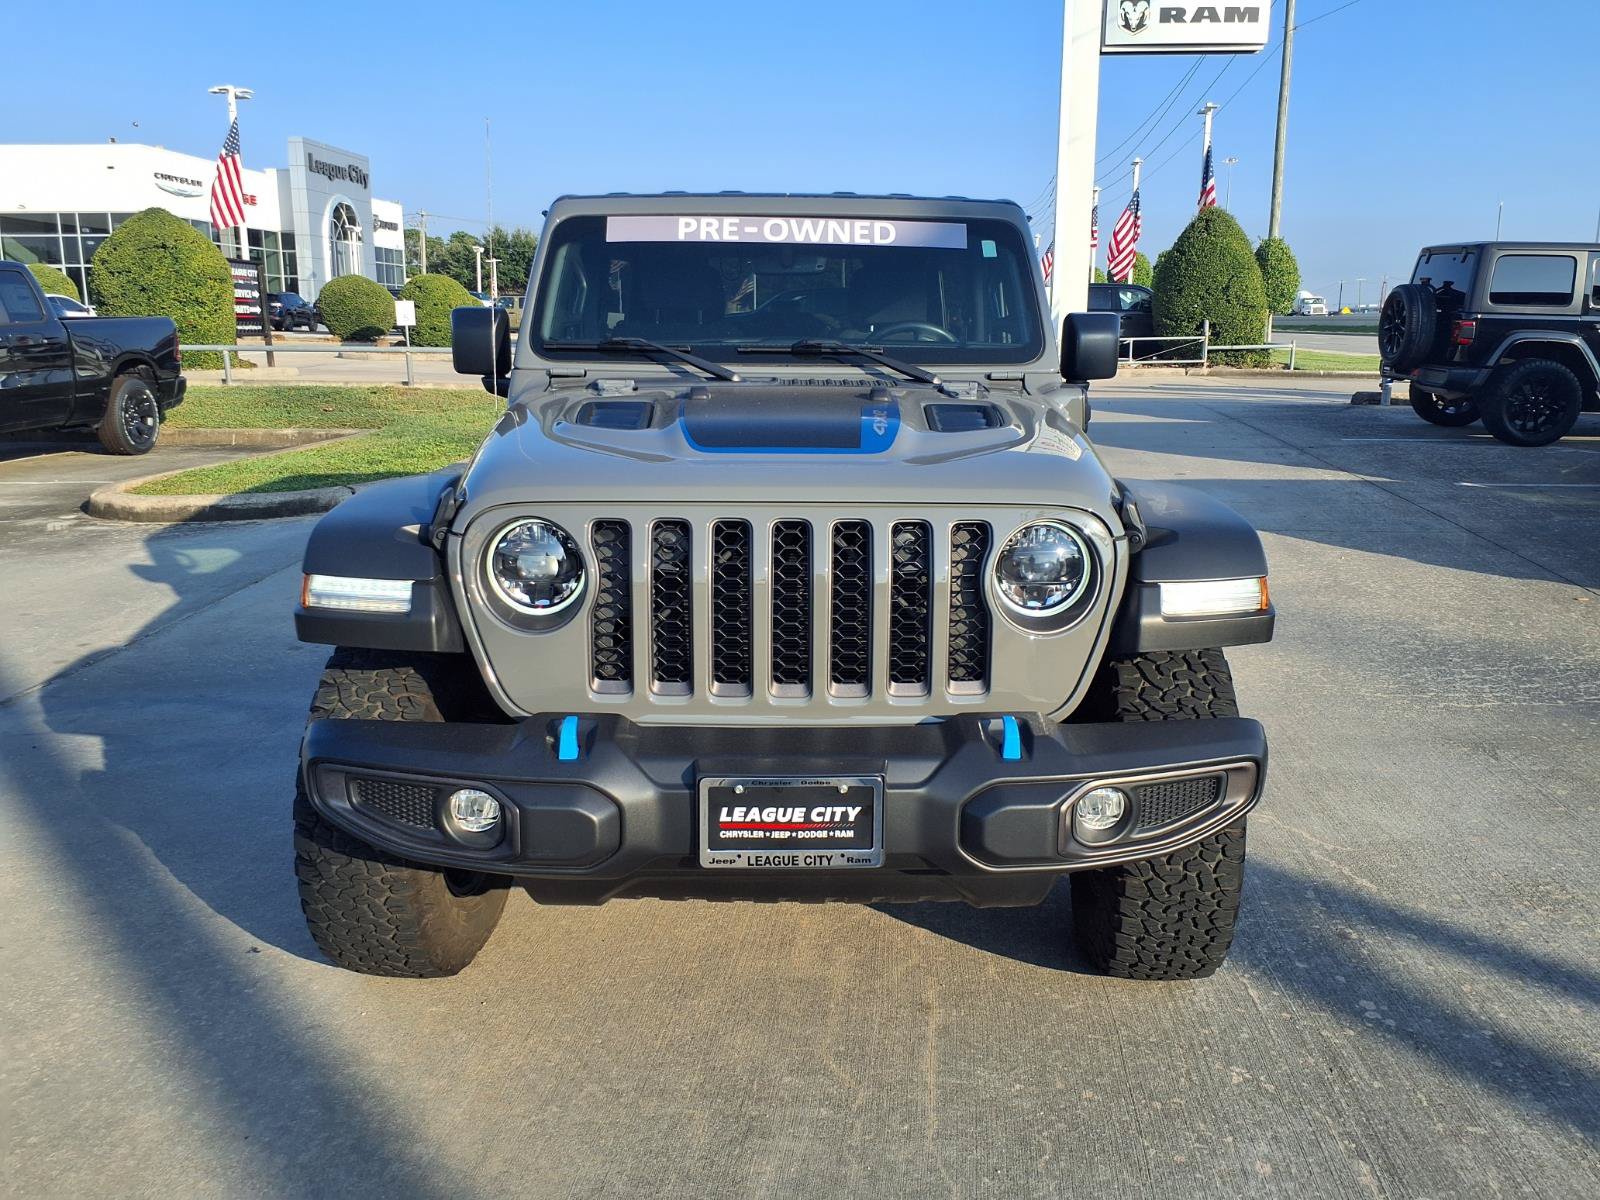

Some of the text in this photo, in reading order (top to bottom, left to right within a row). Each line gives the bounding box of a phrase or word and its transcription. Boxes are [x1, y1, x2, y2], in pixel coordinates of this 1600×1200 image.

[1159, 6, 1260, 24] RAM
[307, 152, 369, 189] League City
[153, 172, 203, 187] CHRYSLER
[677, 216, 897, 245] PRE-OWNED
[719, 806, 862, 823] LEAGUE CITY
[719, 830, 854, 839] CHRYSLER JEEP DODGE RAM
[708, 854, 872, 867] Jeep LEAGUE CITY Ram
